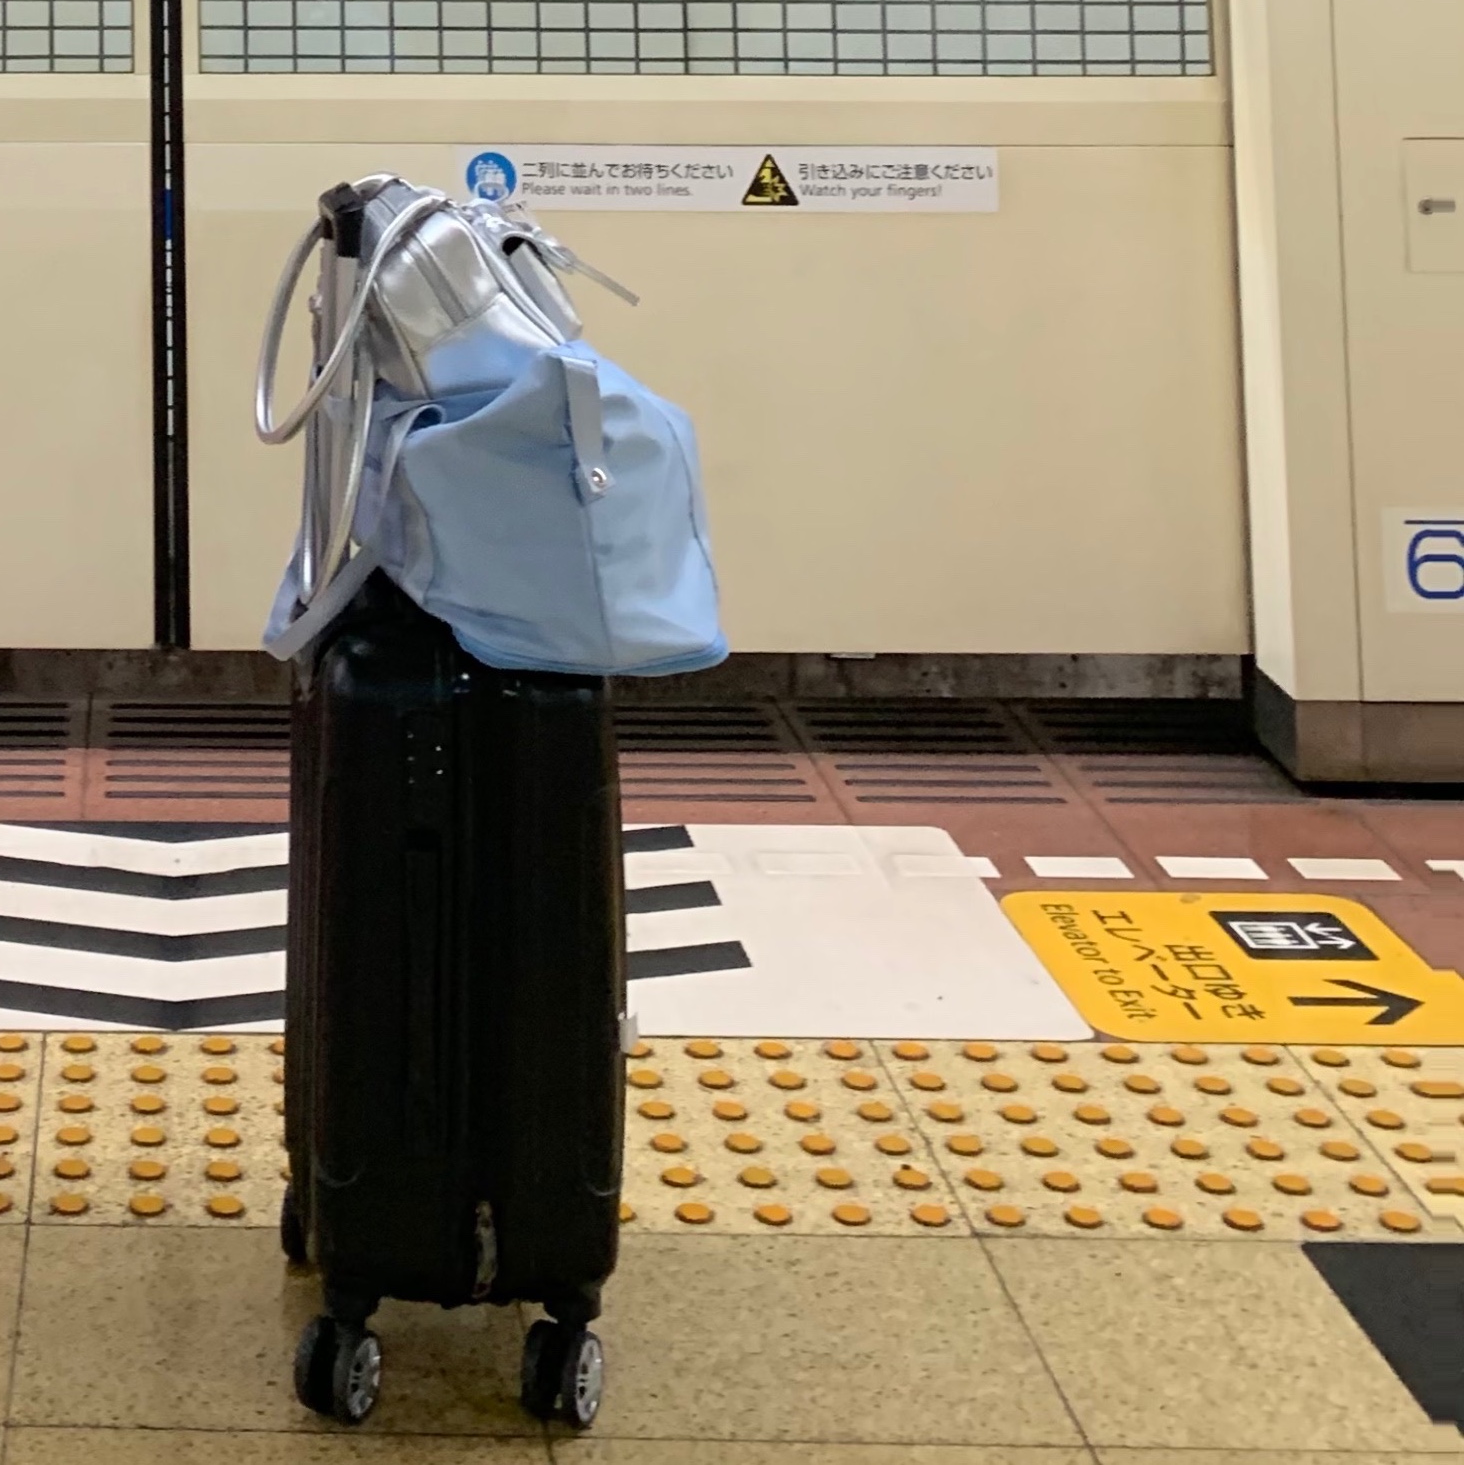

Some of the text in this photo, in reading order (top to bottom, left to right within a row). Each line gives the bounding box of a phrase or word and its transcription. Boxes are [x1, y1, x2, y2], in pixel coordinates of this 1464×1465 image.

[521, 182, 566, 196] Please
[570, 184, 602, 196] wait
[605, 184, 620, 196] in
[623, 184, 653, 196] two
[798, 163, 993, 181] 引き込みにご注意ください
[799, 184, 846, 197] Watch
[850, 186, 883, 200] your
[1039, 903, 1157, 1020] Elevator to Exit
[1091, 909, 1203, 1021] エレベーター
[1163, 944, 1266, 1021] 出口ゆき
